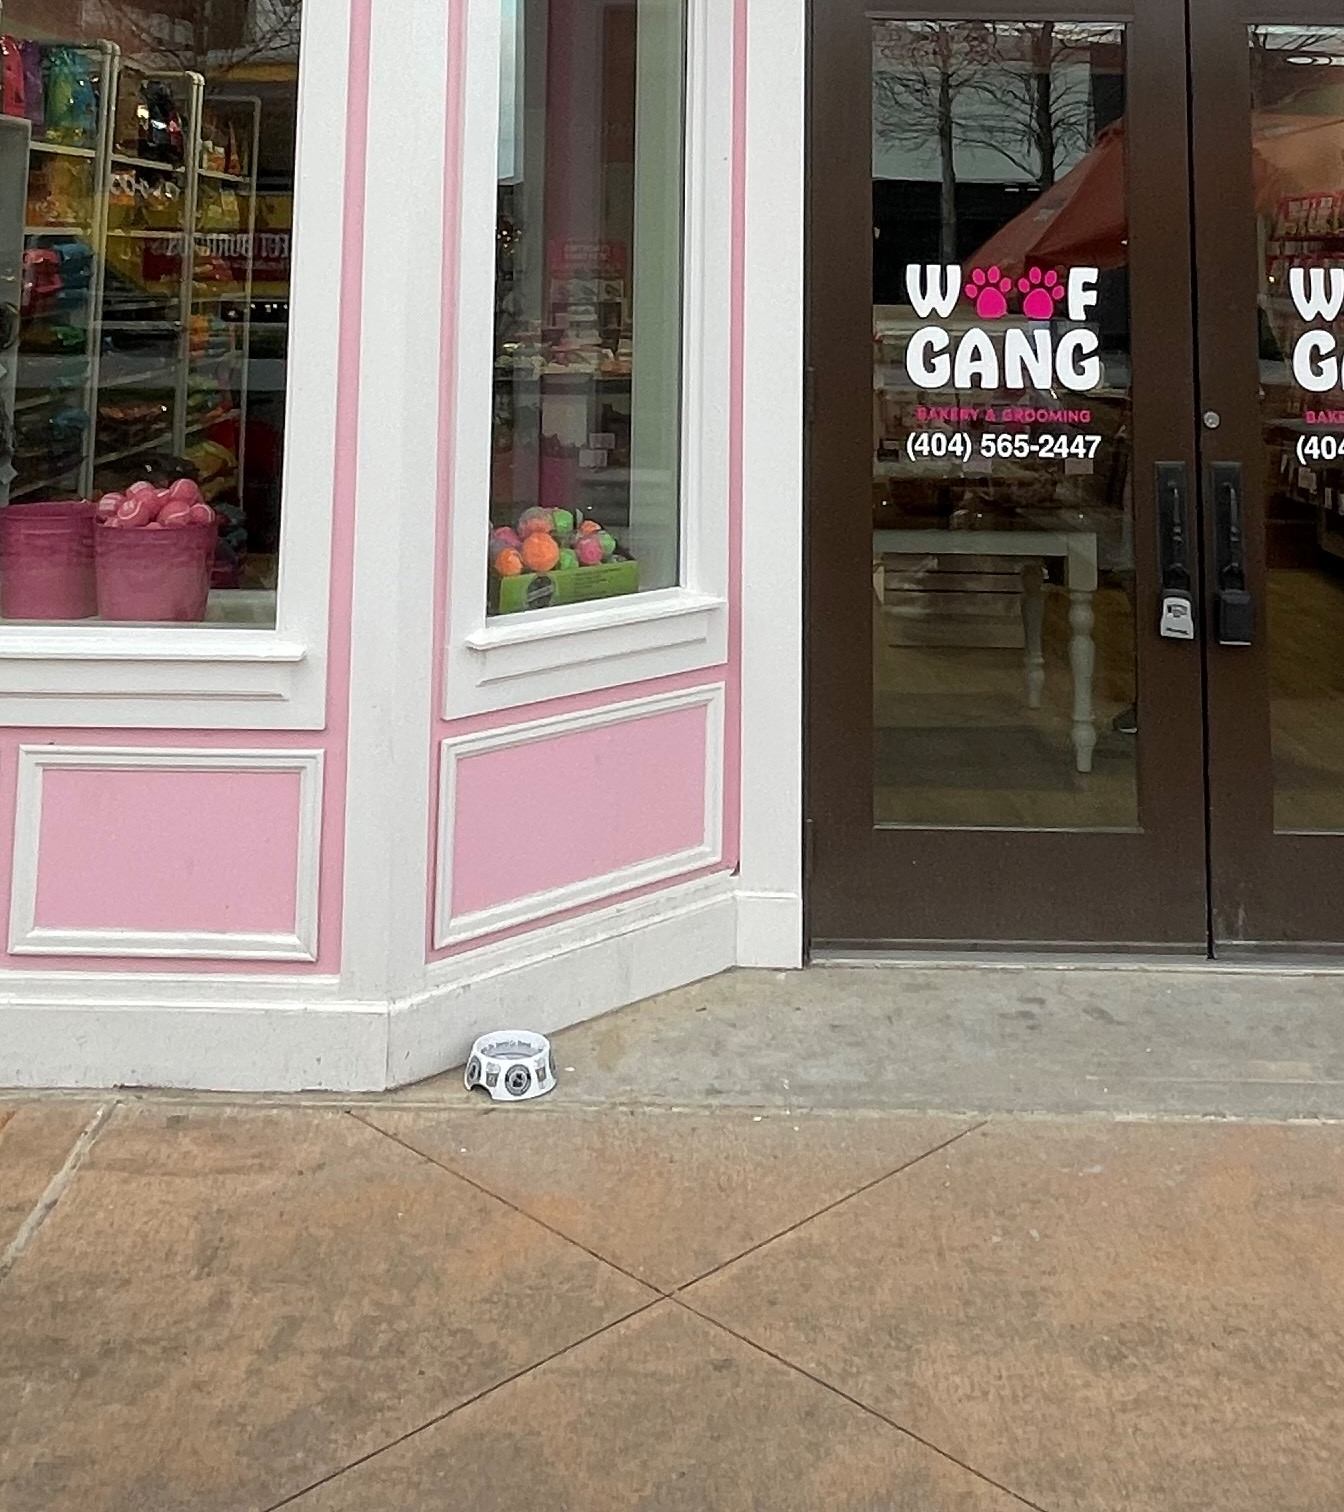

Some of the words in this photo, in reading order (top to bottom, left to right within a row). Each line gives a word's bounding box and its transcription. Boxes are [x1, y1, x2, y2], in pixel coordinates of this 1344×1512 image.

[906, 326, 1100, 390] GANG
[916, 406, 980, 422] BAKERY
[1002, 408, 1092, 424] GROOMING
[906, 432, 973, 463] (404)
[980, 434, 1102, 459] 565-2447
